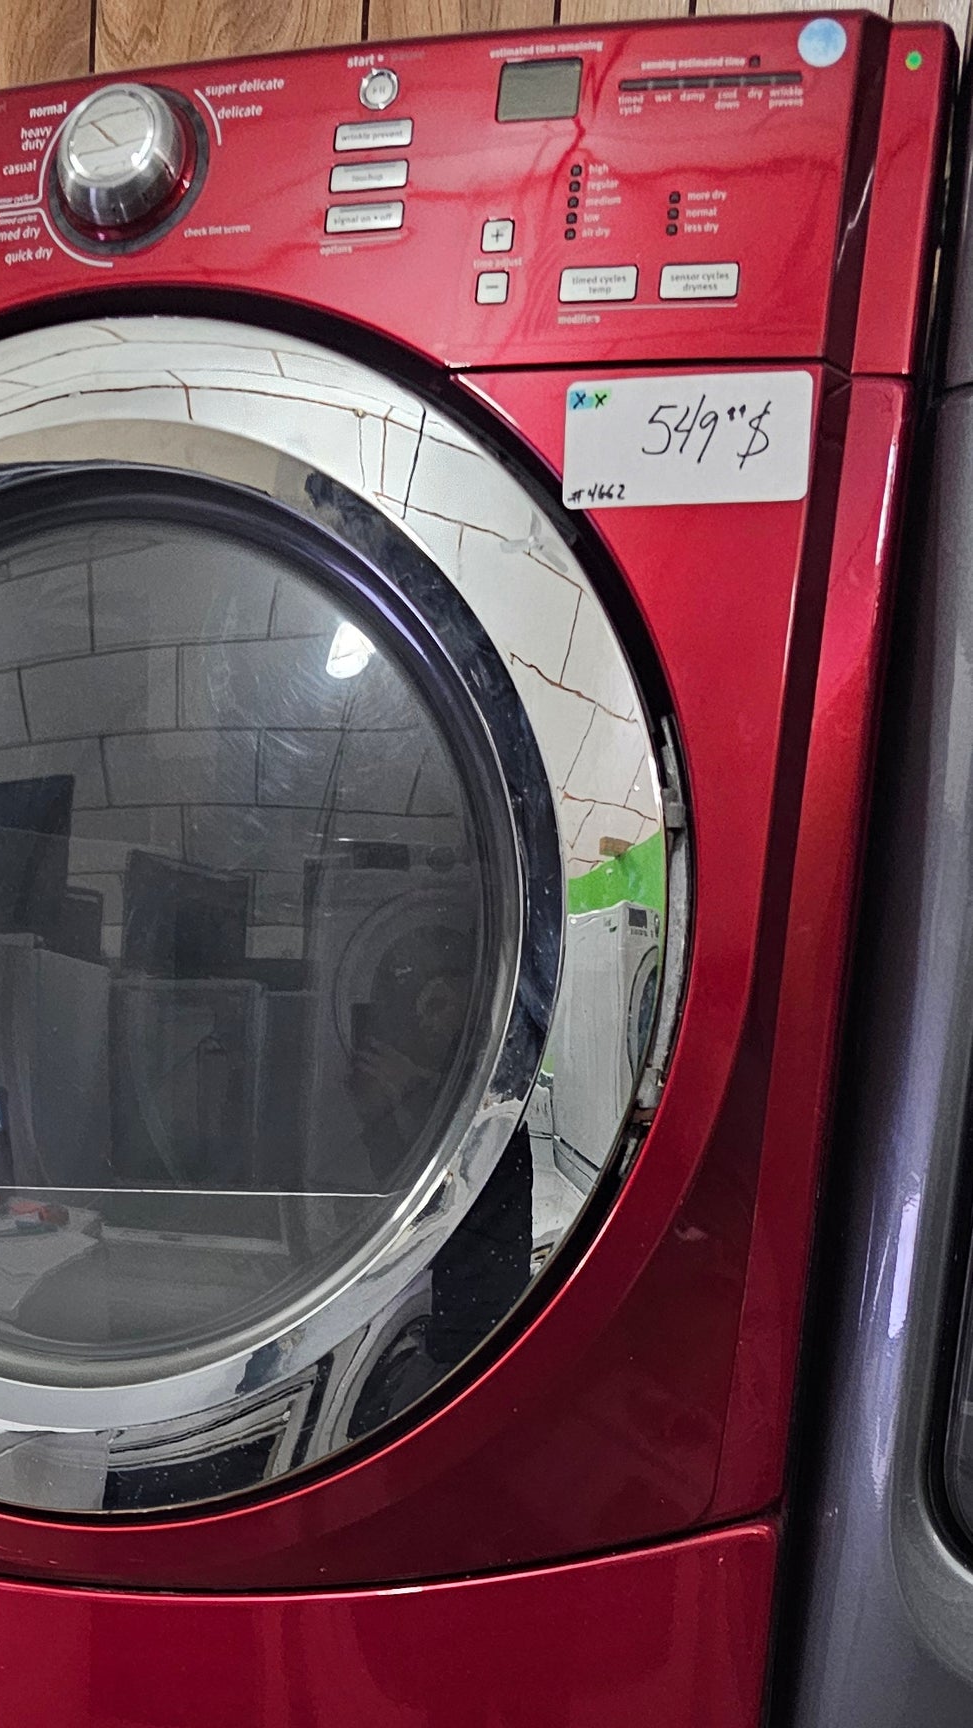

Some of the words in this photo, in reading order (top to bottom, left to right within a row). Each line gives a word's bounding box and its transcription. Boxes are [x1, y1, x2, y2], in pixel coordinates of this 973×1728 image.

[347, 54, 375, 68] start
[205, 84, 237, 98] super
[239, 78, 285, 94] delicate
[30, 101, 67, 118] normal
[217, 105, 263, 120] delicate
[21, 126, 52, 140] heavy
[21, 138, 46, 152] duty
[3, 160, 37, 176] casual
[685, 206, 717, 218] normal
[22, 226, 41, 240] dry
[184, 228, 207, 239] check
[209, 226, 223, 236] lint
[223, 224, 251, 235] screen
[5, 250, 33, 266] quick
[35, 247, 53, 262] dry
[320, 246, 353, 257] options
[572, 275, 598, 286] timed
[599, 274, 627, 286] cycles
[670, 272, 700, 282] sensor
[701, 271, 730, 282] cycles
[588, 286, 612, 296] temp
[683, 282, 719, 293] dryness
